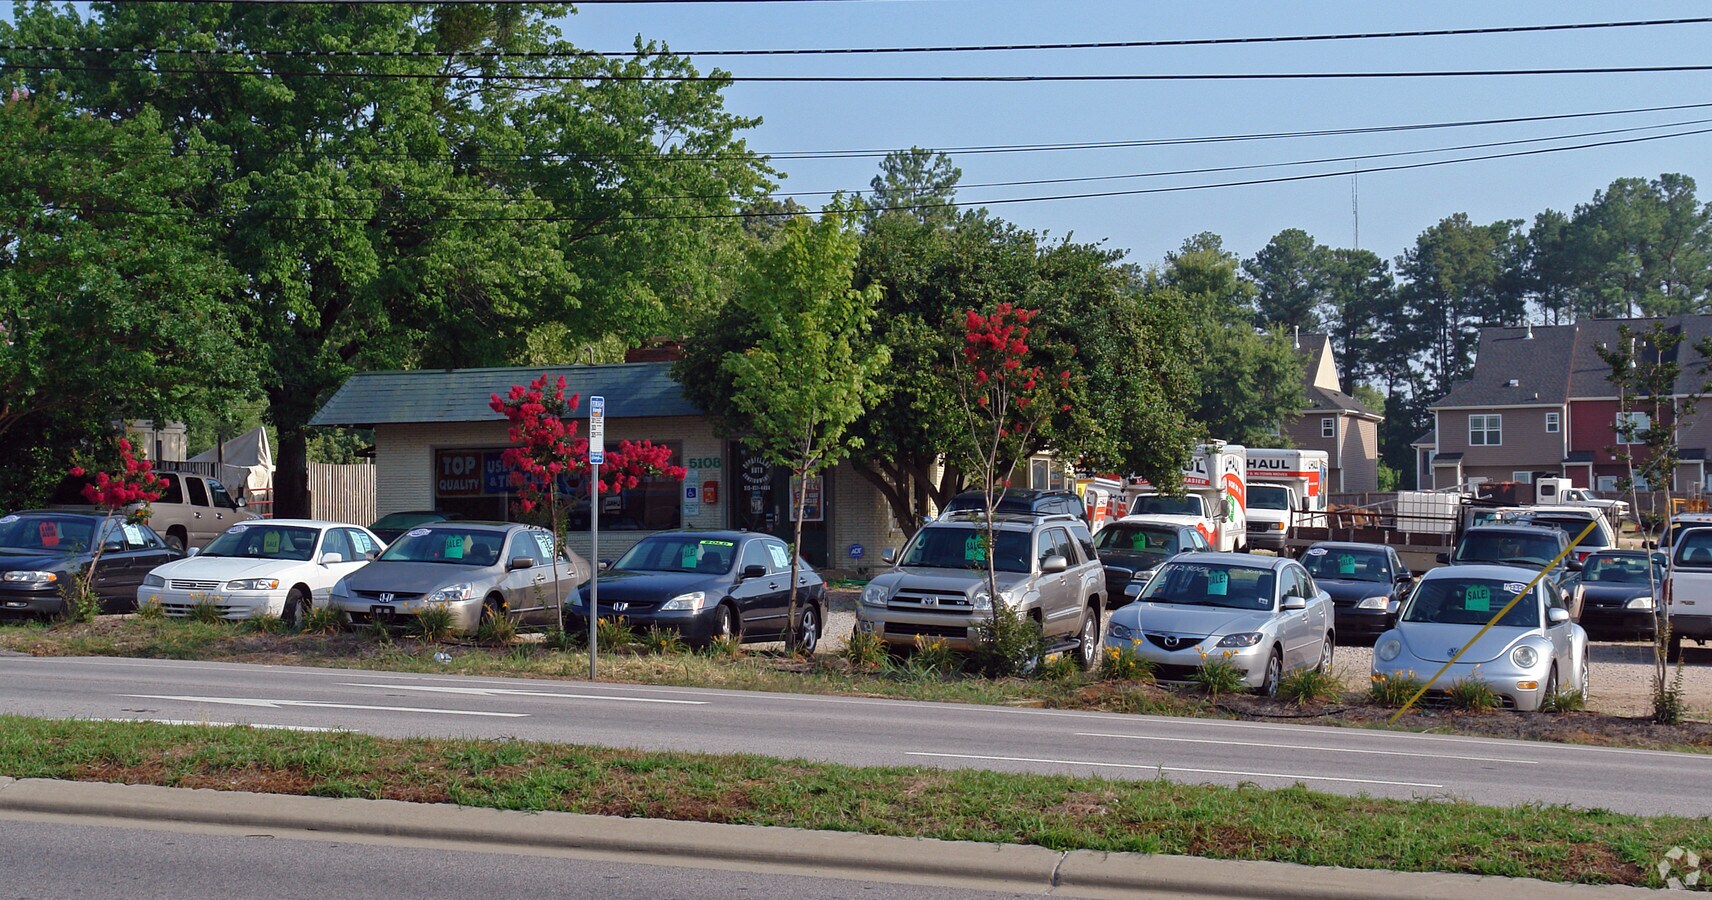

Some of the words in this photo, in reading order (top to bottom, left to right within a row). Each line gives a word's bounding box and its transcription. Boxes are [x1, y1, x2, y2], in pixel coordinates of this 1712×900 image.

[443, 456, 476, 475] TOP
[689, 457, 721, 469] 5108
[1247, 459, 1290, 470] HAUL
[440, 479, 479, 490] QUALITY
[1467, 589, 1488, 601] SALE!
